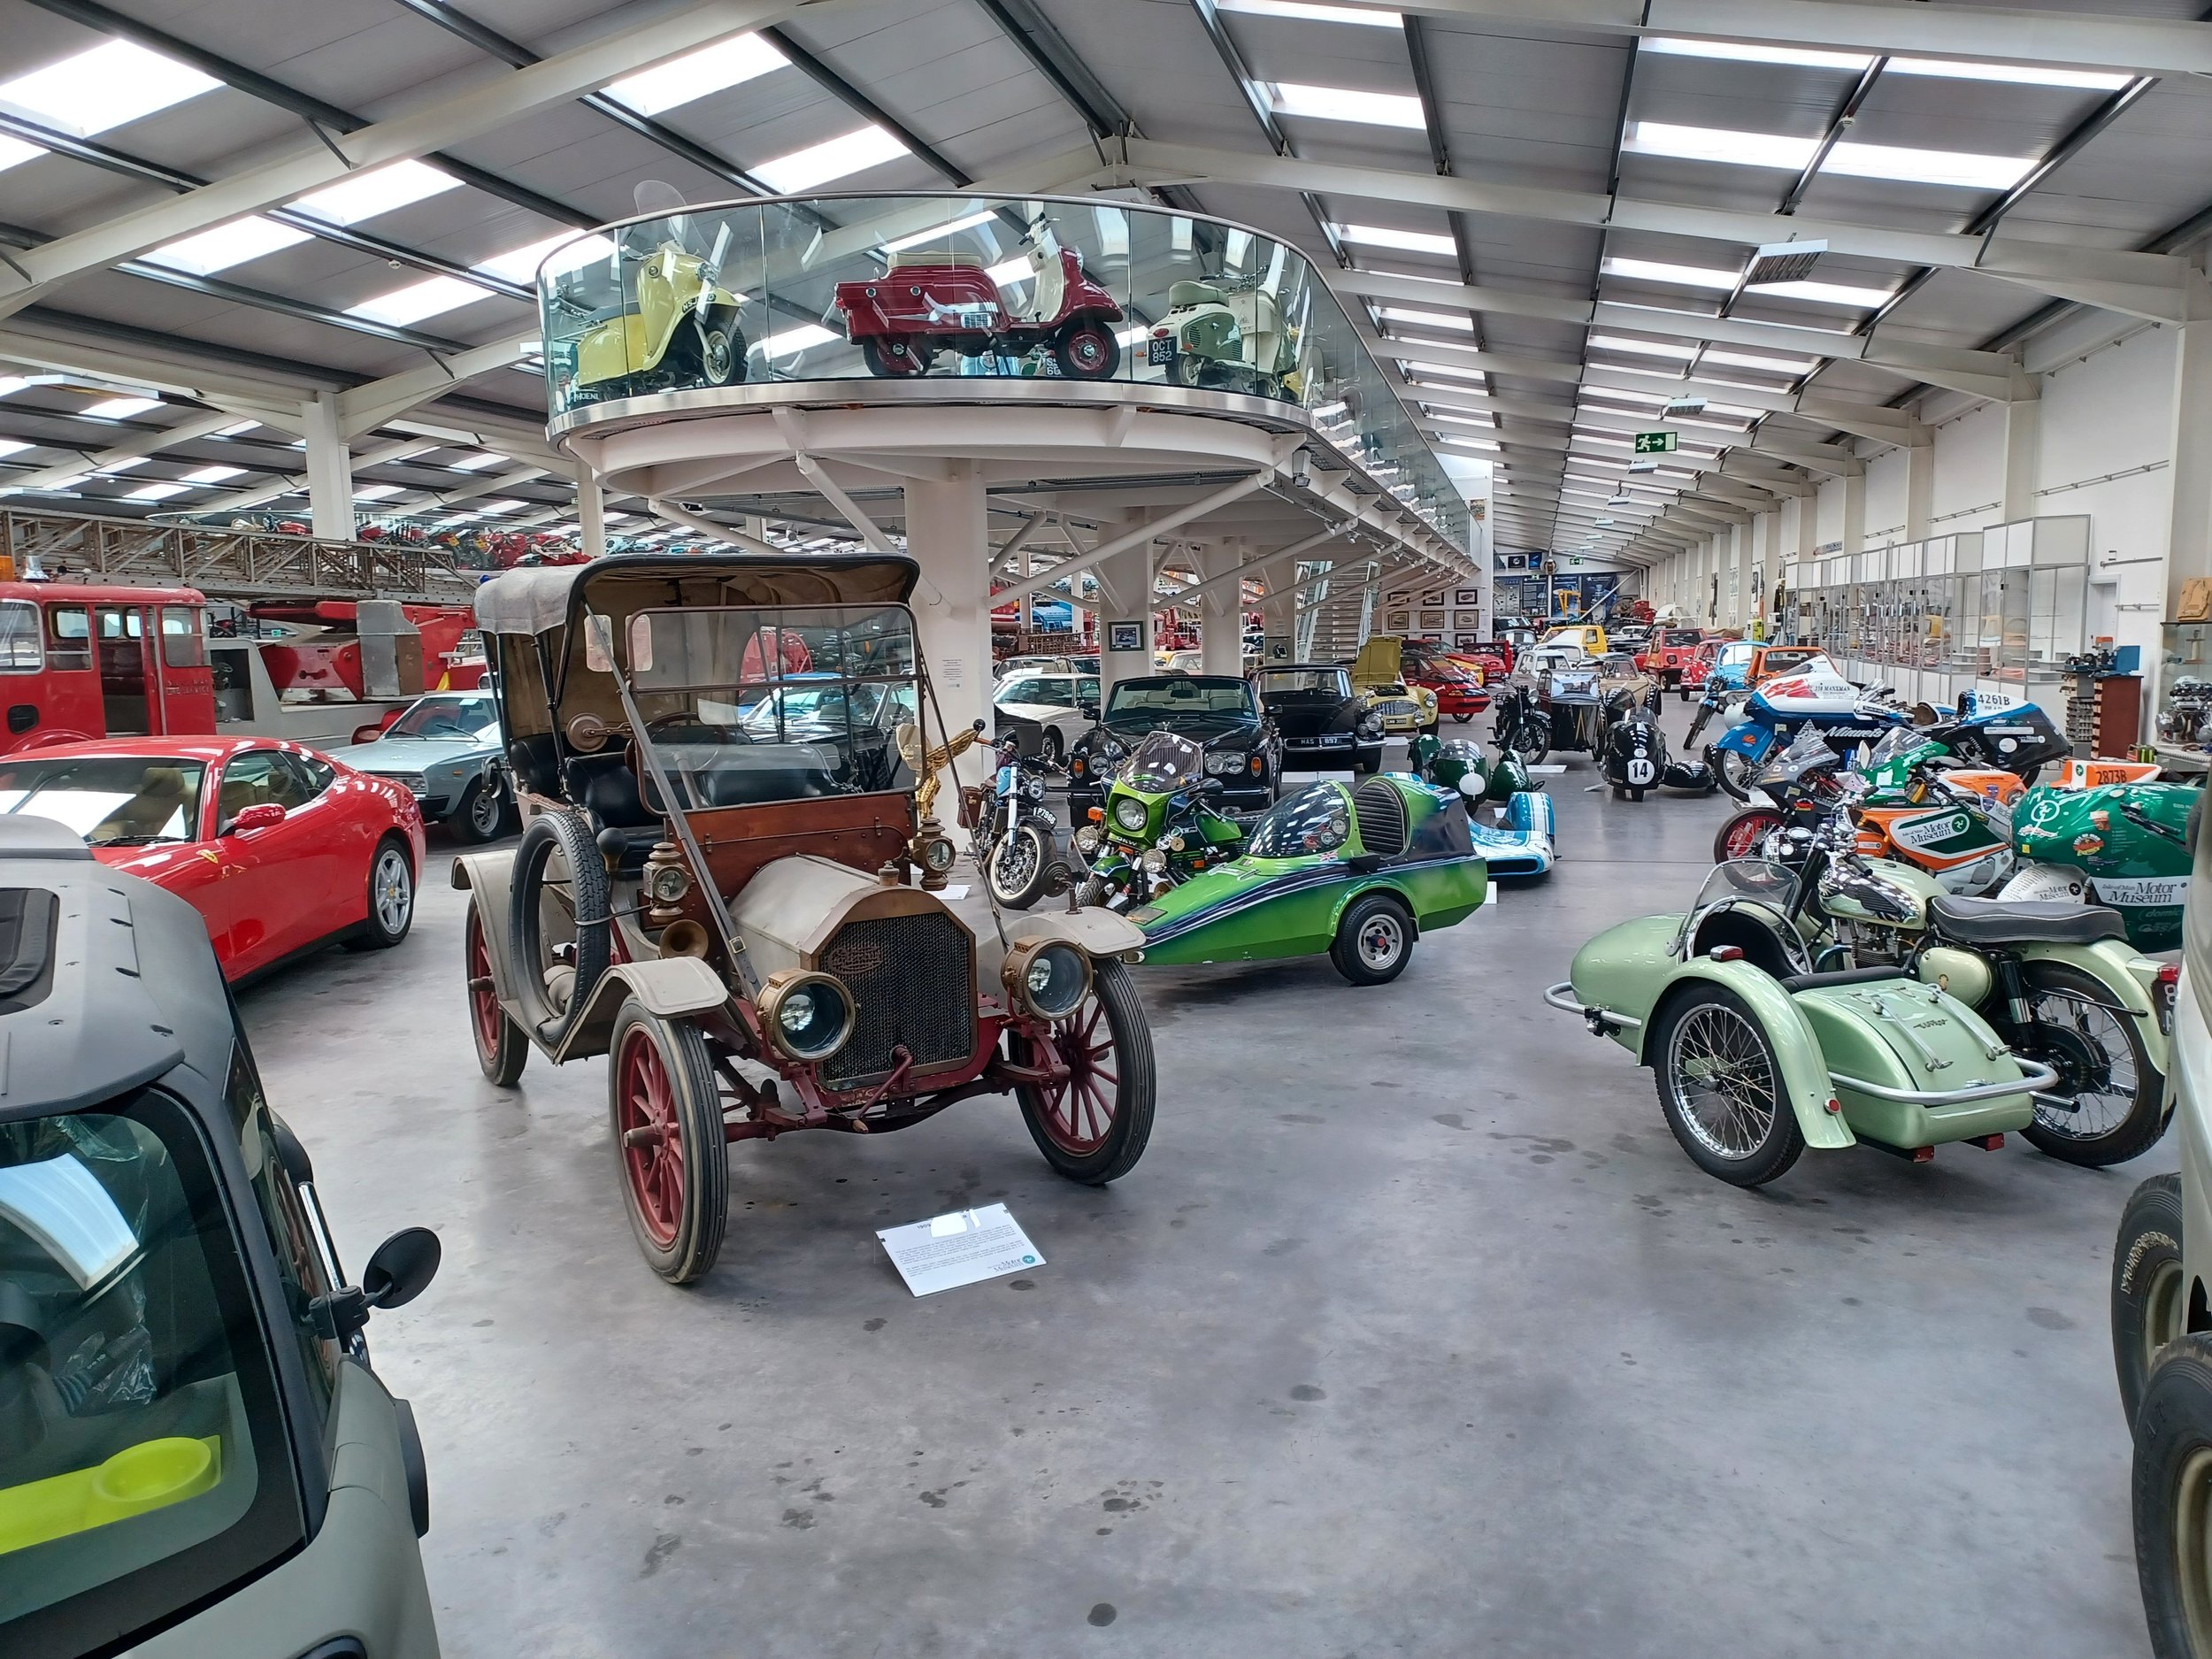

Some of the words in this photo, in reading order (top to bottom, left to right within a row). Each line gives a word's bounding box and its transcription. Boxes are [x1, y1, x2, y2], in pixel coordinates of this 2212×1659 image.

[1152, 340, 1172, 352] OCT
[1152, 350, 1172, 363] 852
[1712, 680, 1724, 691] 21
[1978, 694, 2010, 705] 4261B
[1632, 762, 1648, 778] 14
[2095, 769, 2127, 785] 2873B
[1923, 821, 1951, 834] Motor
[1116, 836, 1138, 846] DKW
[1911, 828, 1952, 844] Museum
[2135, 882, 2177, 895] Motor
[2108, 891, 2172, 902] Museum
